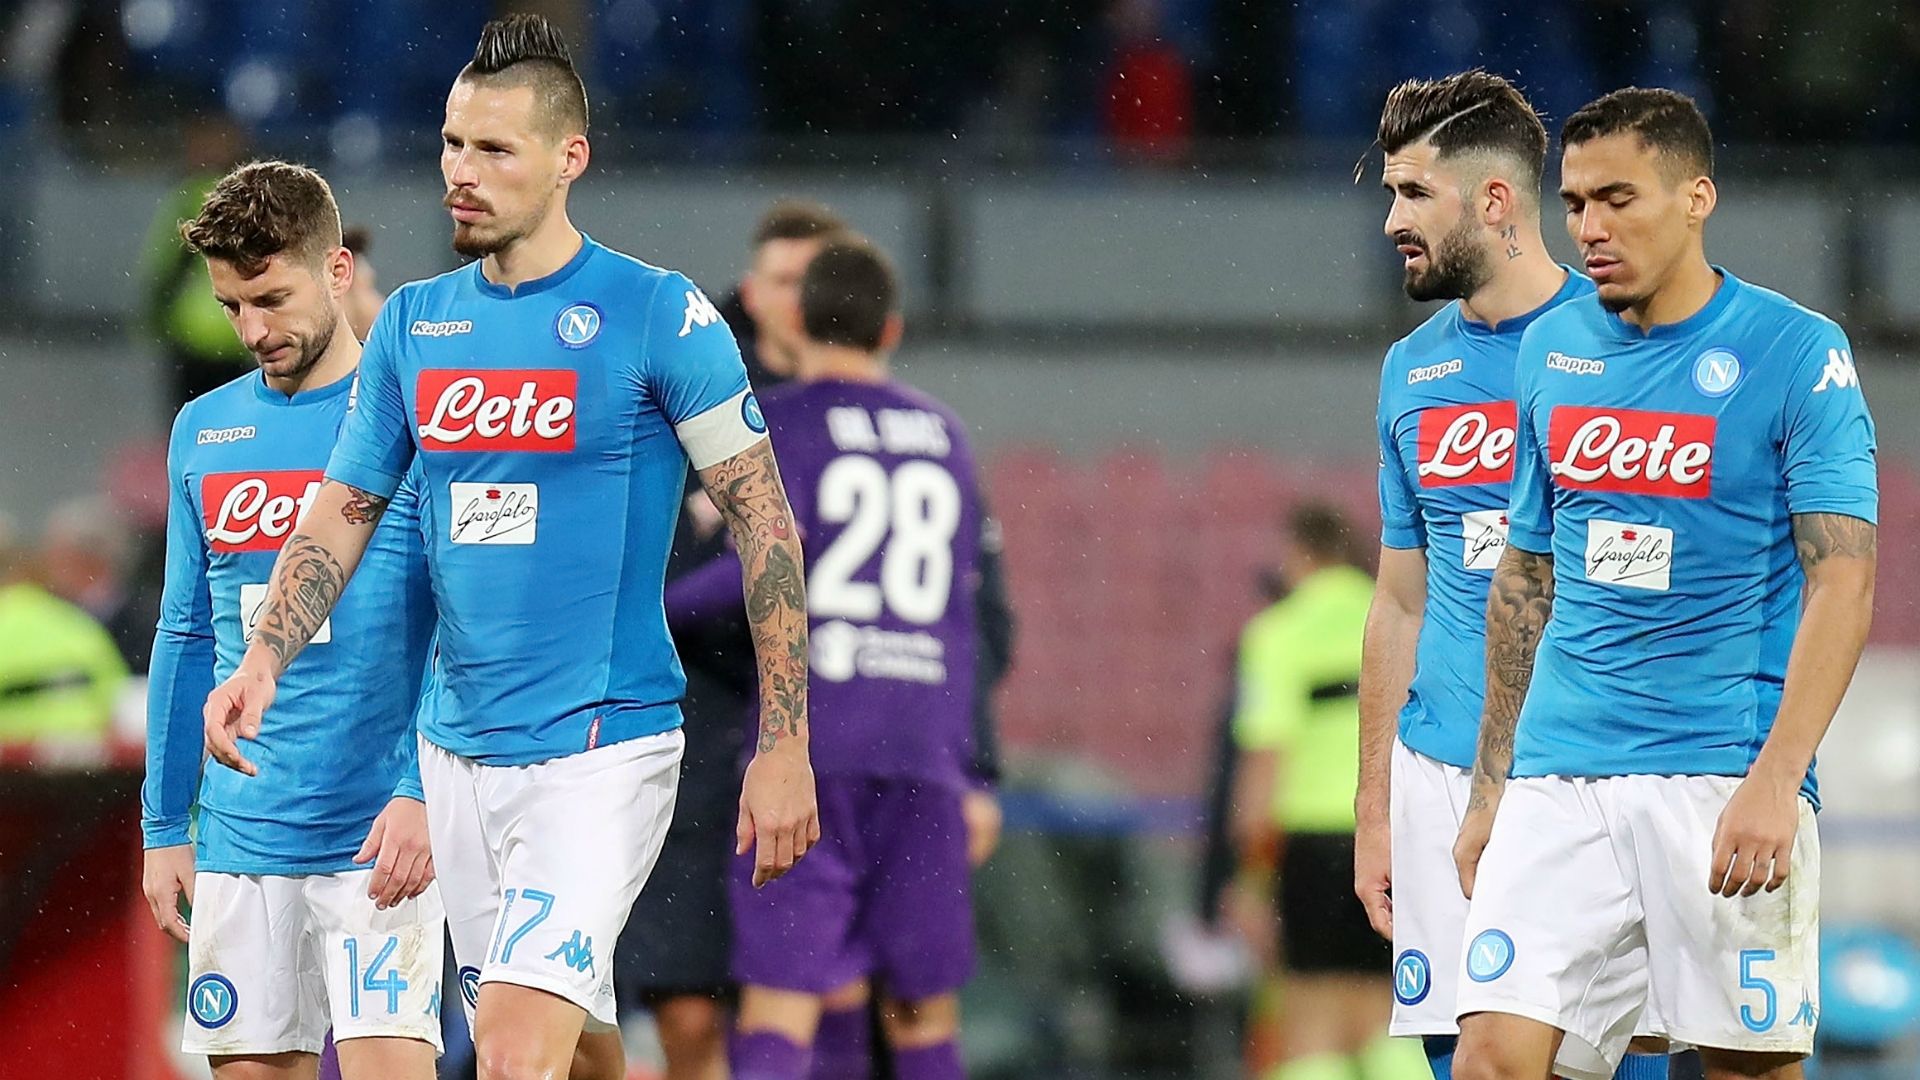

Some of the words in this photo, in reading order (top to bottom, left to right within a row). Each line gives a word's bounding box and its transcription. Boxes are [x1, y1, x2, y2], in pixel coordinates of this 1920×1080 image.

[411, 320, 473, 337] Kappa
[566, 313, 592, 336] N
[1408, 359, 1463, 384] Kappa
[1547, 352, 1605, 375] Kappa
[1706, 360, 1732, 384] N
[418, 376, 575, 442] Lete
[197, 426, 257, 445] Kappa
[1418, 411, 1516, 479] Le
[1550, 414, 1712, 485] Lete
[452, 491, 537, 542] Garofalo
[808, 454, 961, 625] 28
[1587, 534, 1670, 582] Garofalo
[489, 888, 556, 965] 17
[1478, 943, 1500, 969] N
[344, 936, 408, 1018] 14
[1401, 964, 1419, 991] N
[1739, 949, 1777, 1033] 5
[200, 987, 223, 1015] N
